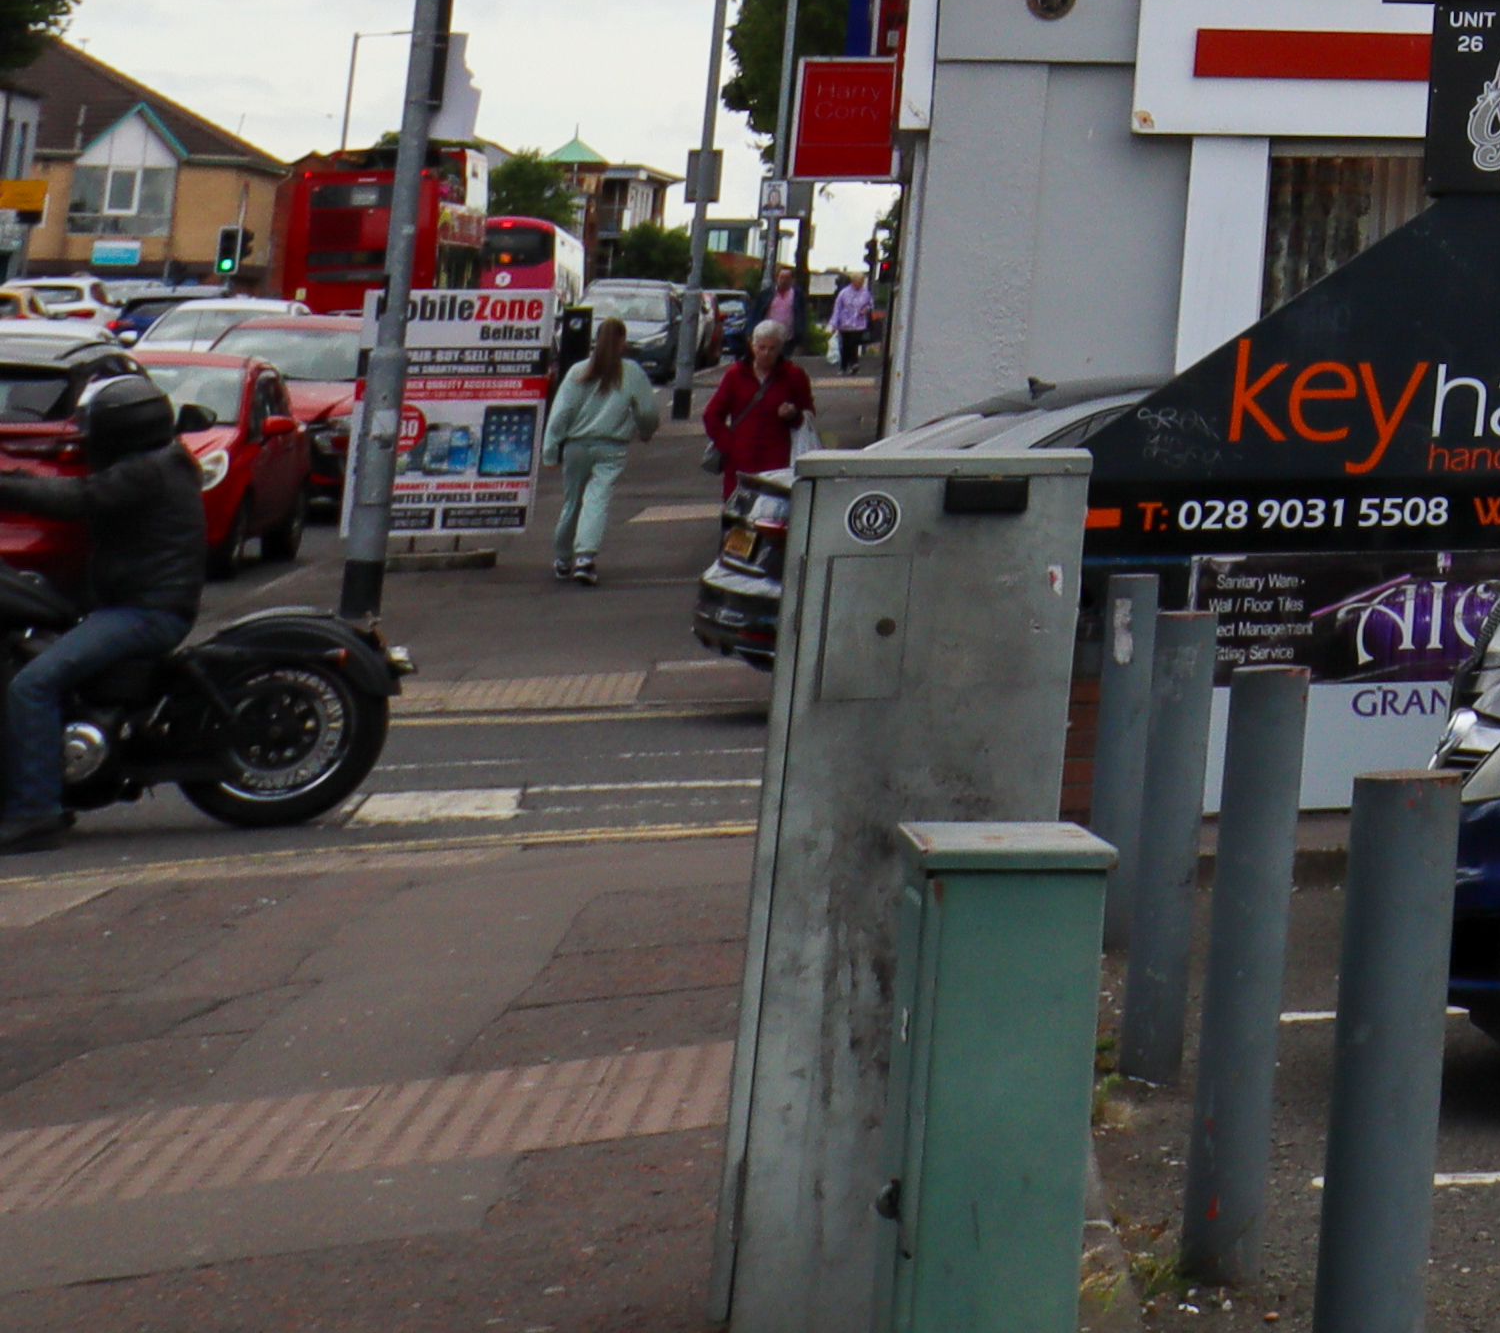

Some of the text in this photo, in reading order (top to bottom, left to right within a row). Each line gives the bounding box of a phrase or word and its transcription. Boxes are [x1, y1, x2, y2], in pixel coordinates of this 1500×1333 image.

[1450, 11, 1497, 28] UNIT
[1457, 35, 1483, 52] 26
[816, 81, 883, 102] Harry
[814, 101, 880, 122] Corry
[480, 325, 541, 341] Belfast
[1137, 501, 1169, 531] T:
[1178, 500, 1248, 530] 028
[1258, 498, 1345, 529] 9031
[1358, 497, 1449, 528] 5508
[1216, 574, 1299, 592] Sanitary Ware
[1209, 597, 1304, 613] Wall Floor Tiles
[1238, 620, 1314, 638] Management
[1249, 645, 1294, 661] Service
[1352, 688, 1448, 717] GRAN
